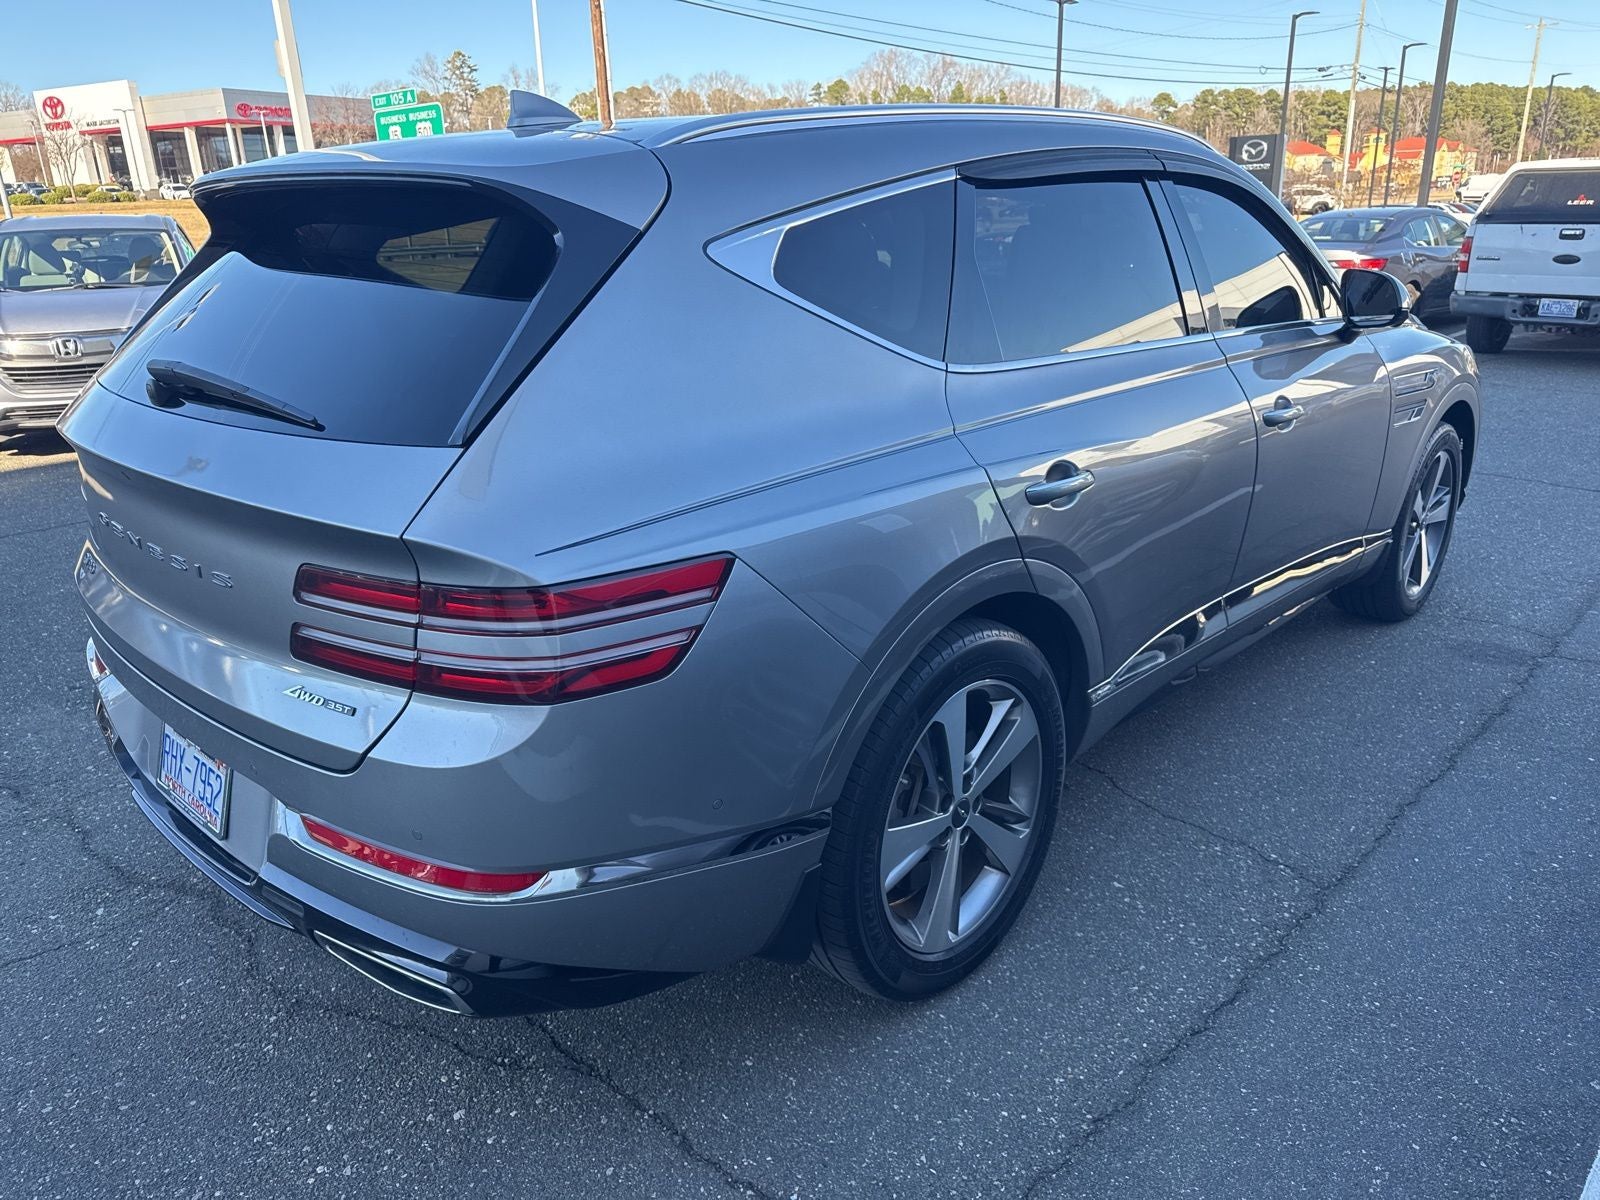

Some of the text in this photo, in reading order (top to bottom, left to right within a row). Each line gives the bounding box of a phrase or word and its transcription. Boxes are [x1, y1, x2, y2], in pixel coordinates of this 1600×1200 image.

[390, 93, 404, 105] 105
[406, 91, 414, 103] A
[44, 121, 73, 131] TOYOTA
[380, 110, 437, 125] BUSINESS BUSINESS
[99, 511, 233, 588] GENESIS
[282, 685, 325, 706] AWD
[161, 732, 222, 816] RHX-7952
[164, 774, 186, 800] NORTH
[187, 793, 219, 829] CAROLINA
